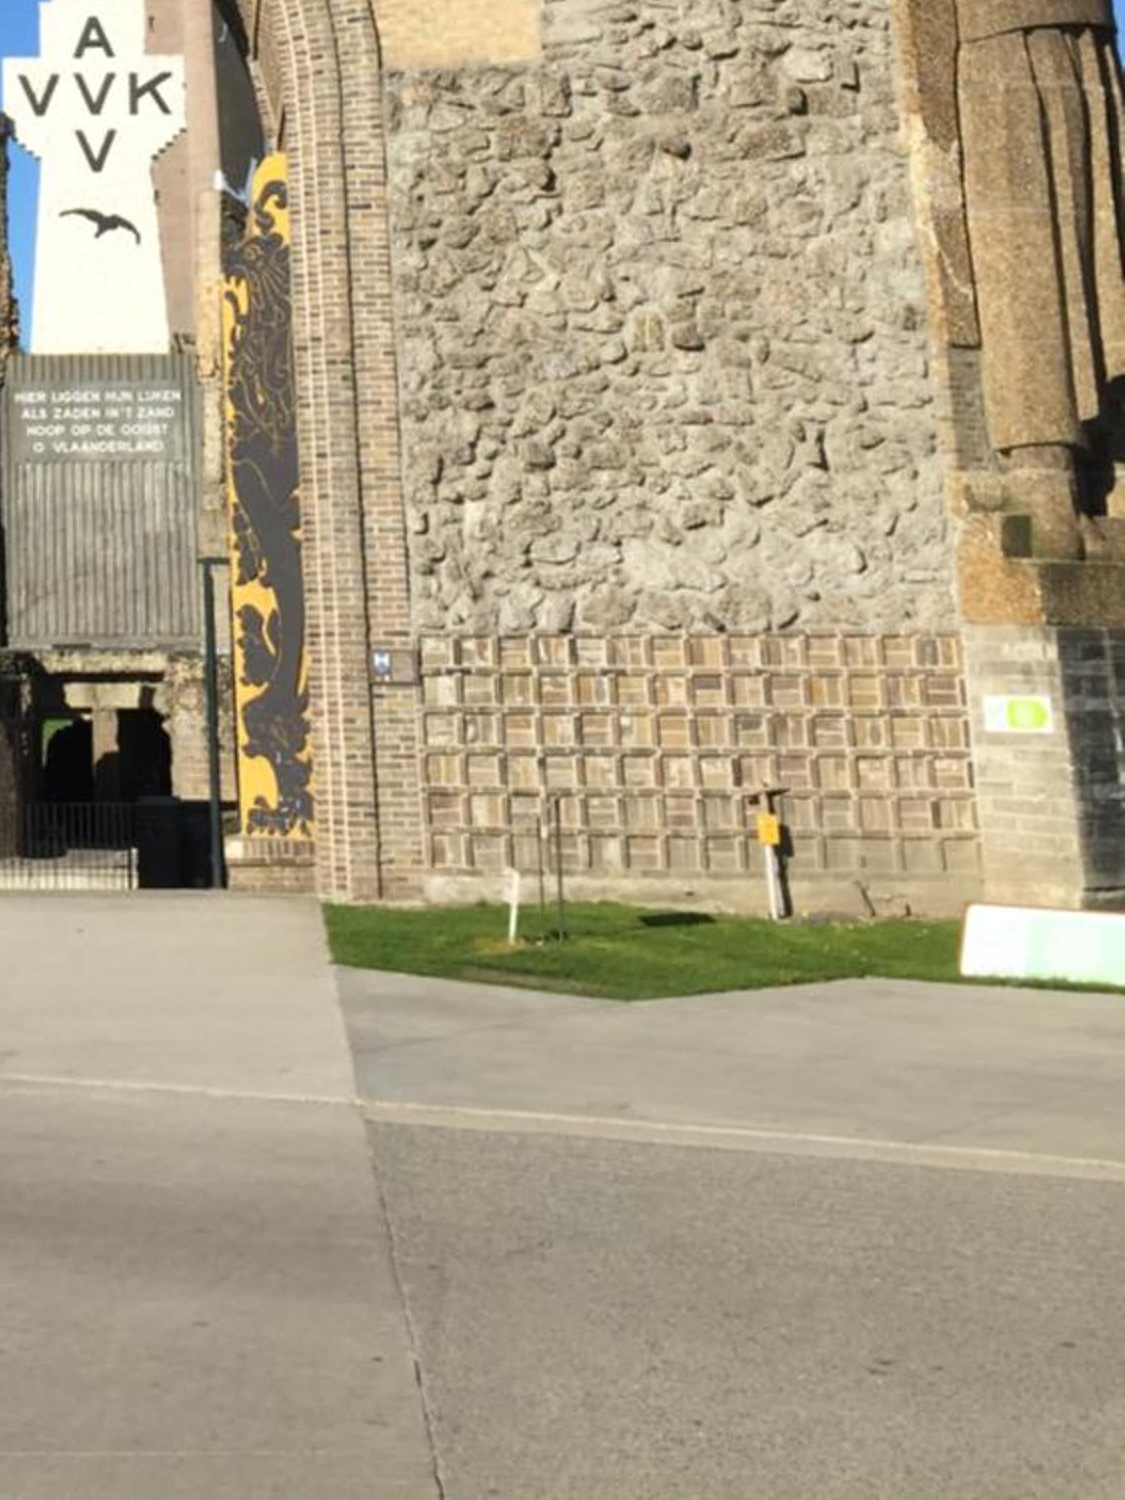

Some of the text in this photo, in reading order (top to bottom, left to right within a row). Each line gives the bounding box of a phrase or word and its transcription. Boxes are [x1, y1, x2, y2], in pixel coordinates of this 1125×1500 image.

[74, 16, 114, 58] A
[75, 129, 117, 173] V
[14, 393, 46, 404] HIER
[51, 391, 100, 403] LIGGEN
[104, 391, 134, 402] HUN
[22, 408, 47, 420] ALS
[53, 408, 100, 419] ZADEN
[104, 408, 119, 418] IN
[137, 407, 175, 419] ZAND
[26, 423, 168, 436] HOOP OP DE OOGST
[33, 441, 165, 453] O VLAANDERLAND
